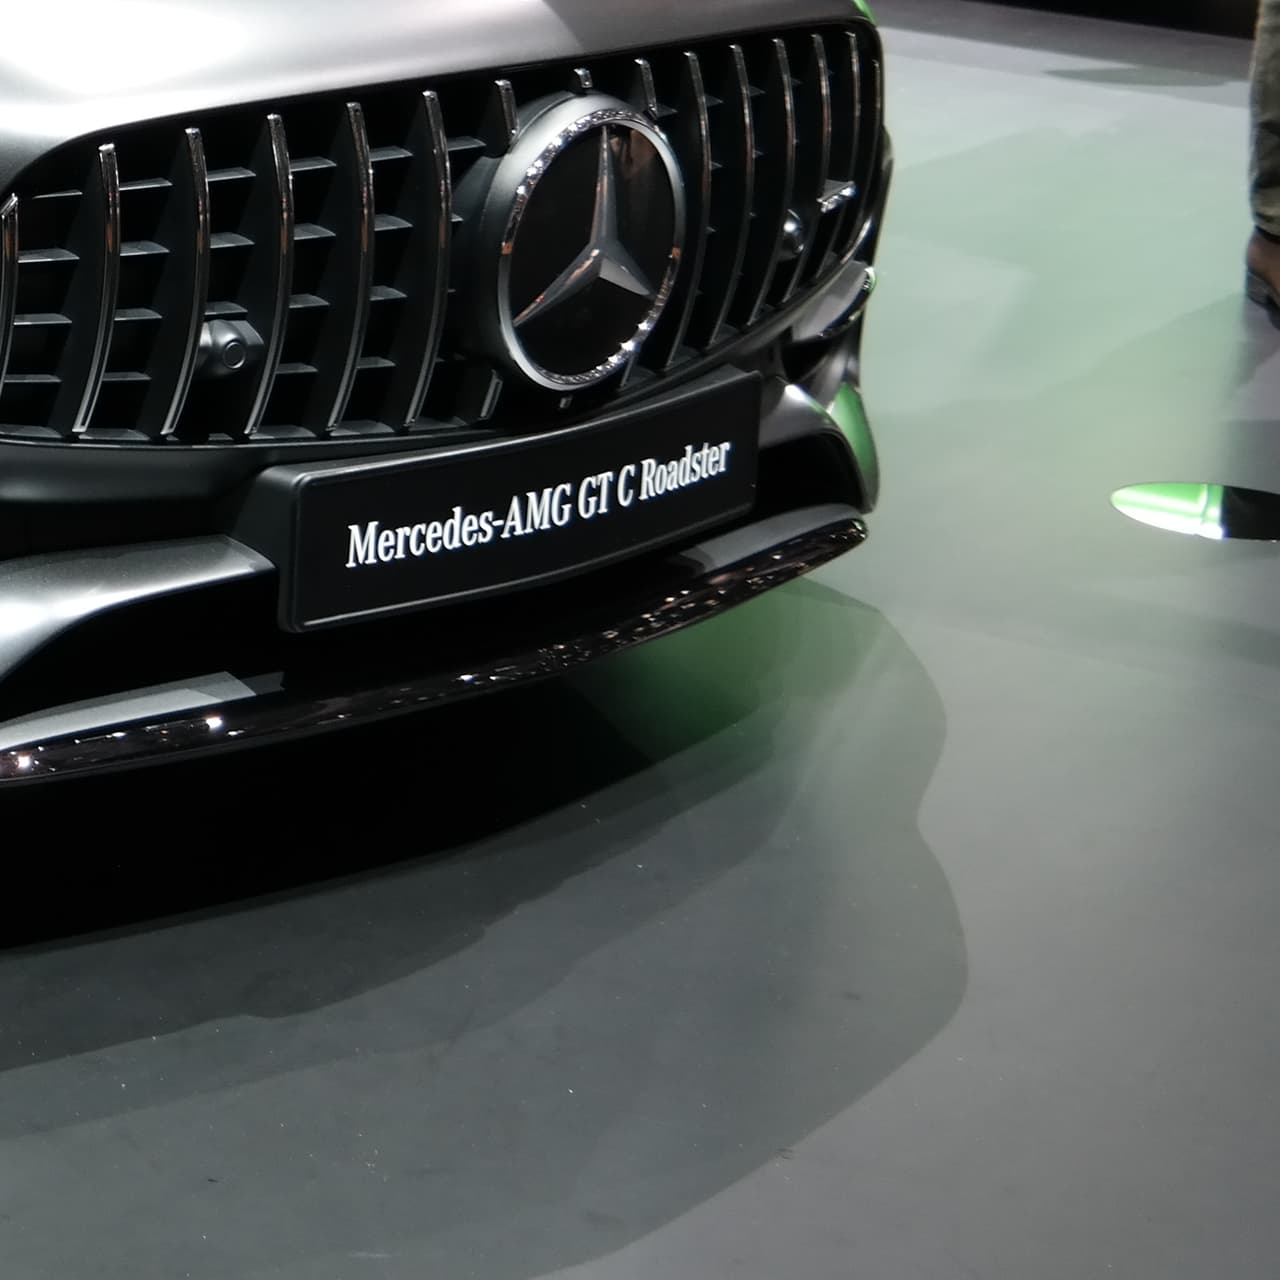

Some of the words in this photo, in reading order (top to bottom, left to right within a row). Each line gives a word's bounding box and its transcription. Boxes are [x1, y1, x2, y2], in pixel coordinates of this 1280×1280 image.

[345, 481, 572, 569] Mercedes-AMG
[577, 472, 613, 519] GT
[618, 465, 636, 508] C
[639, 440, 732, 502] Roadster
